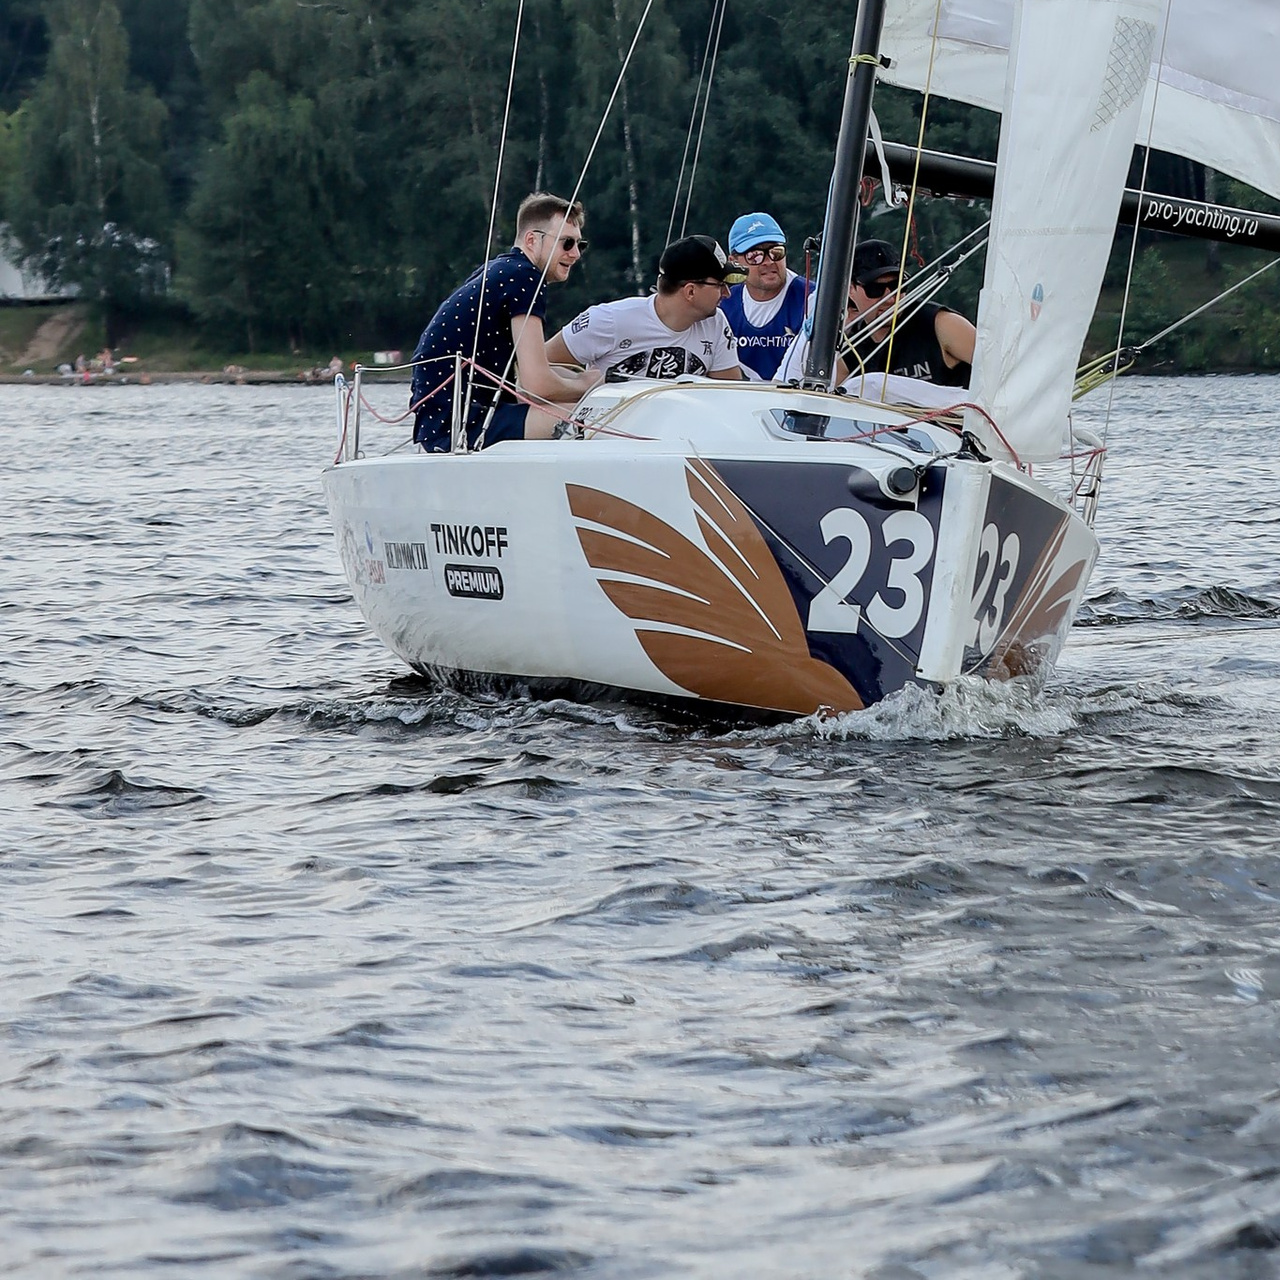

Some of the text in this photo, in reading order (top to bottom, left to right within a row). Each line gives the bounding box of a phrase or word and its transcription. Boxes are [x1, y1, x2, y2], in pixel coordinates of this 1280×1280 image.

[1144, 200, 1259, 238] pro-yachting.ru
[430, 523, 509, 558] TINKOFF
[446, 569, 501, 594] PREMIUM
[807, 507, 935, 639] 23
[964, 522, 1021, 656] 23
